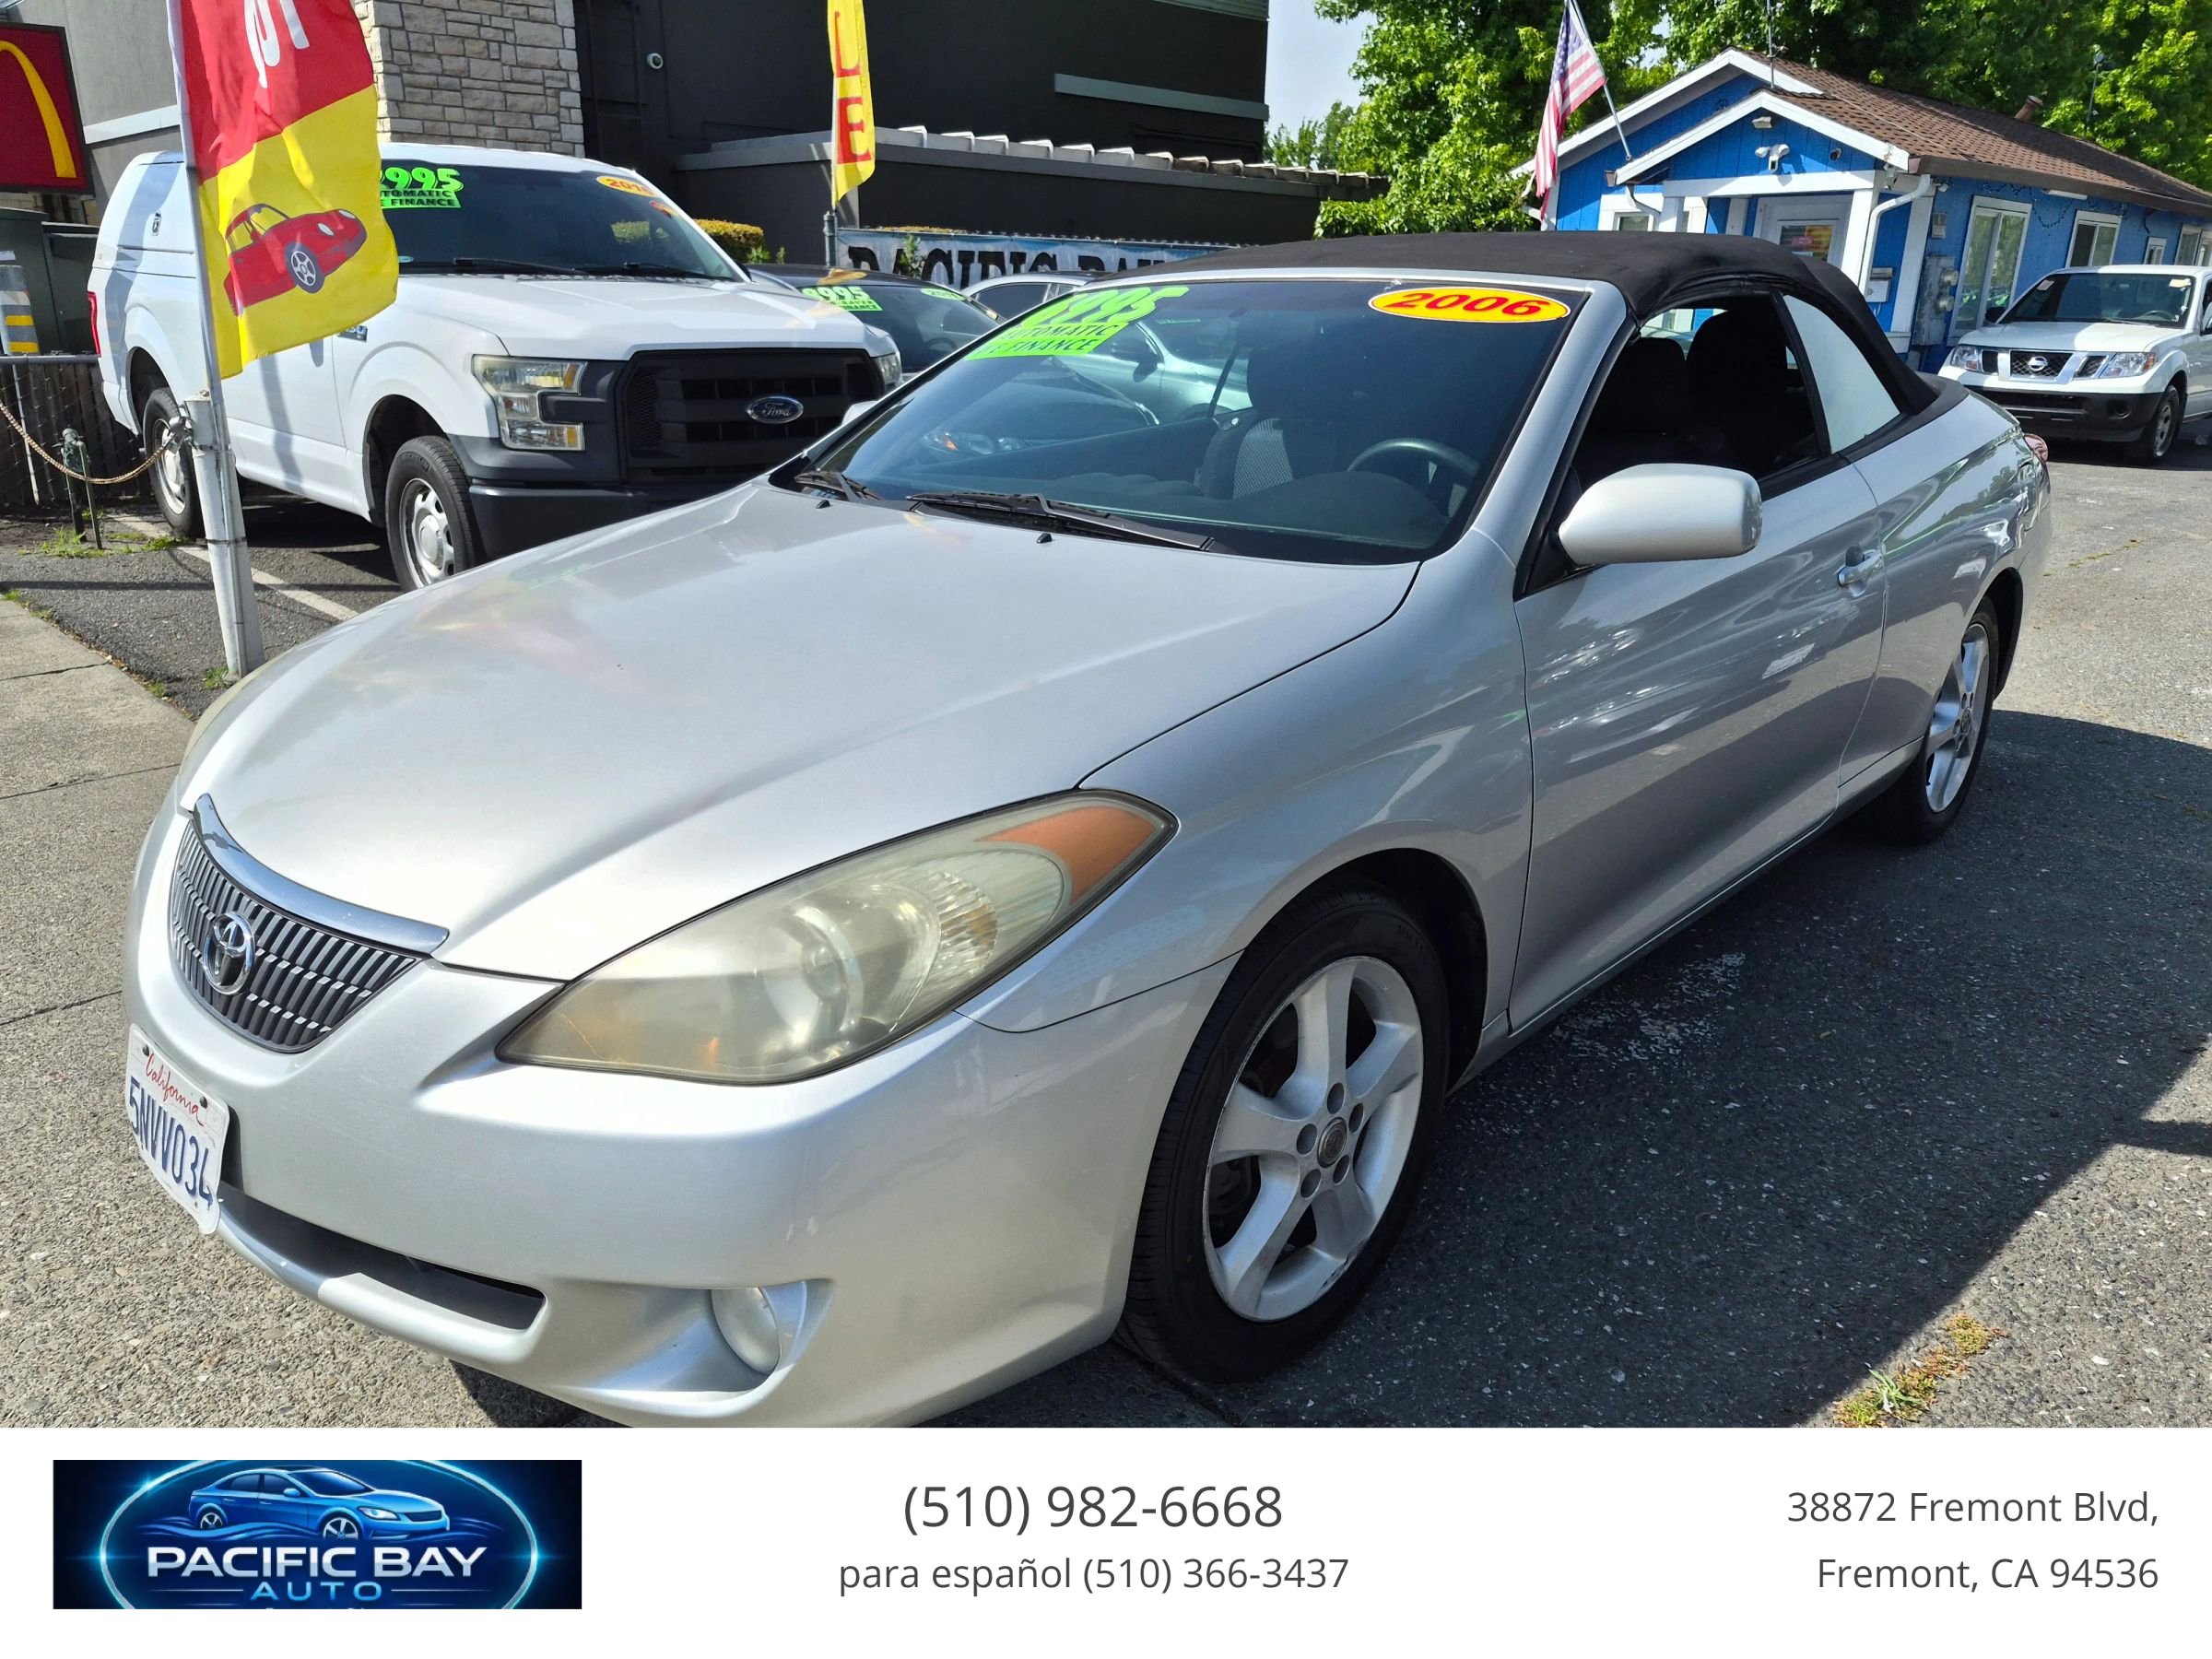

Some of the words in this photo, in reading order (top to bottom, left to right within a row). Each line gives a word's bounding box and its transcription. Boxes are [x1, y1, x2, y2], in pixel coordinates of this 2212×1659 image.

[380, 167, 464, 191] 995
[1384, 292, 1551, 316] 2006
[1002, 324, 1119, 340] AUTOMATIC
[1004, 338, 1100, 353] FINANCE
[146, 1053, 206, 1126] California
[129, 1076, 213, 1208] 5NVV034
